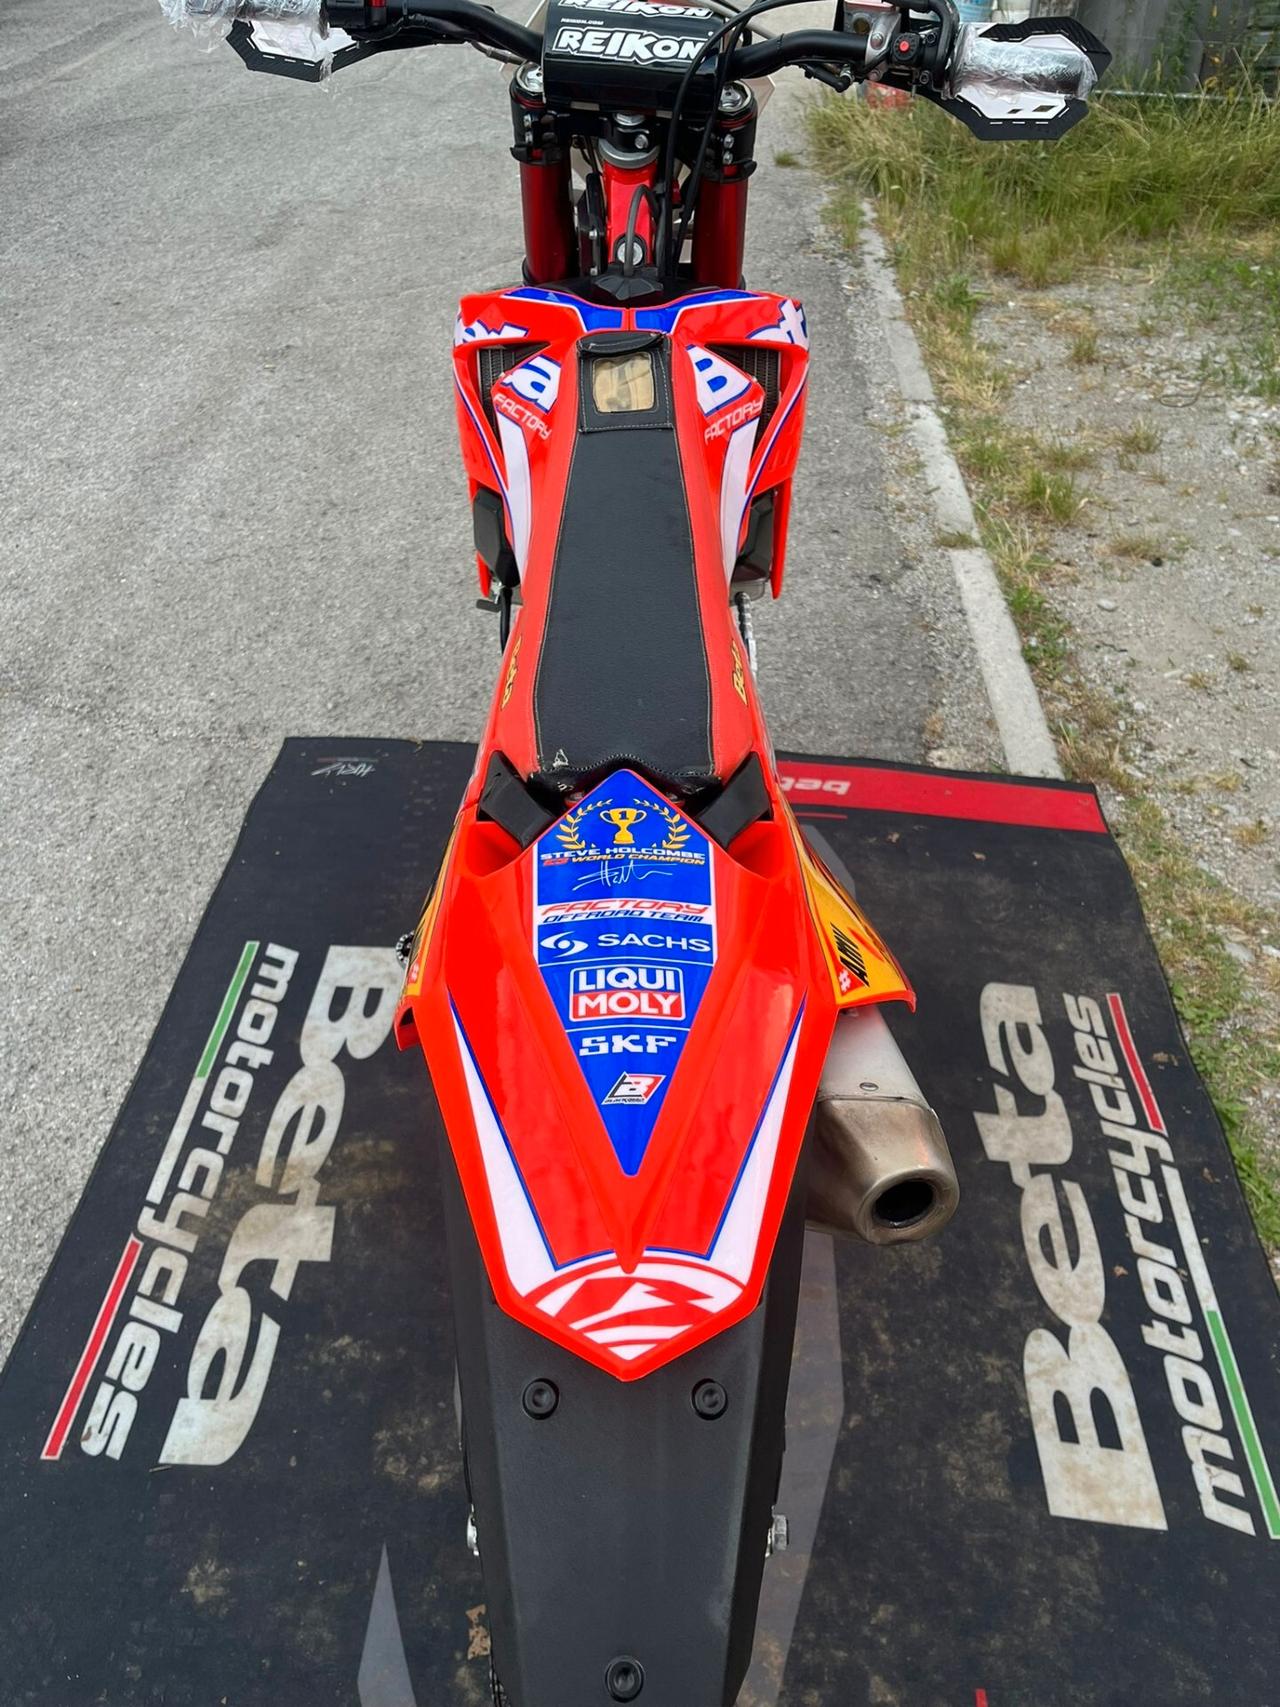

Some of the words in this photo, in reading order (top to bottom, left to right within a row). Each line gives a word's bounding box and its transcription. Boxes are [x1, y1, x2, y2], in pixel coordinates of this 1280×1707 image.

[558, 30, 705, 60] REIKON
[493, 393, 552, 440] FACTORY
[703, 399, 762, 445] FACTORY
[779, 776, 851, 795] bet
[540, 848, 600, 860] STEVE
[605, 846, 705, 859] HOLCOMBE
[572, 854, 625, 863] WORLD
[628, 854, 705, 865] CHAMPION
[541, 900, 708, 916] FACTORY
[543, 910, 643, 923] OFFROAD
[649, 911, 704, 922] TEAM
[597, 933, 711, 952] SACHS
[578, 967, 675, 991] LIQUI
[578, 992, 679, 1017] MOLY
[579, 1034, 677, 1056] SKF
[80, 943, 299, 1461] motorcycles
[158, 944, 404, 1466] Beta
[973, 981, 1168, 1531] Beta
[1062, 992, 1256, 1537] motorcycles
